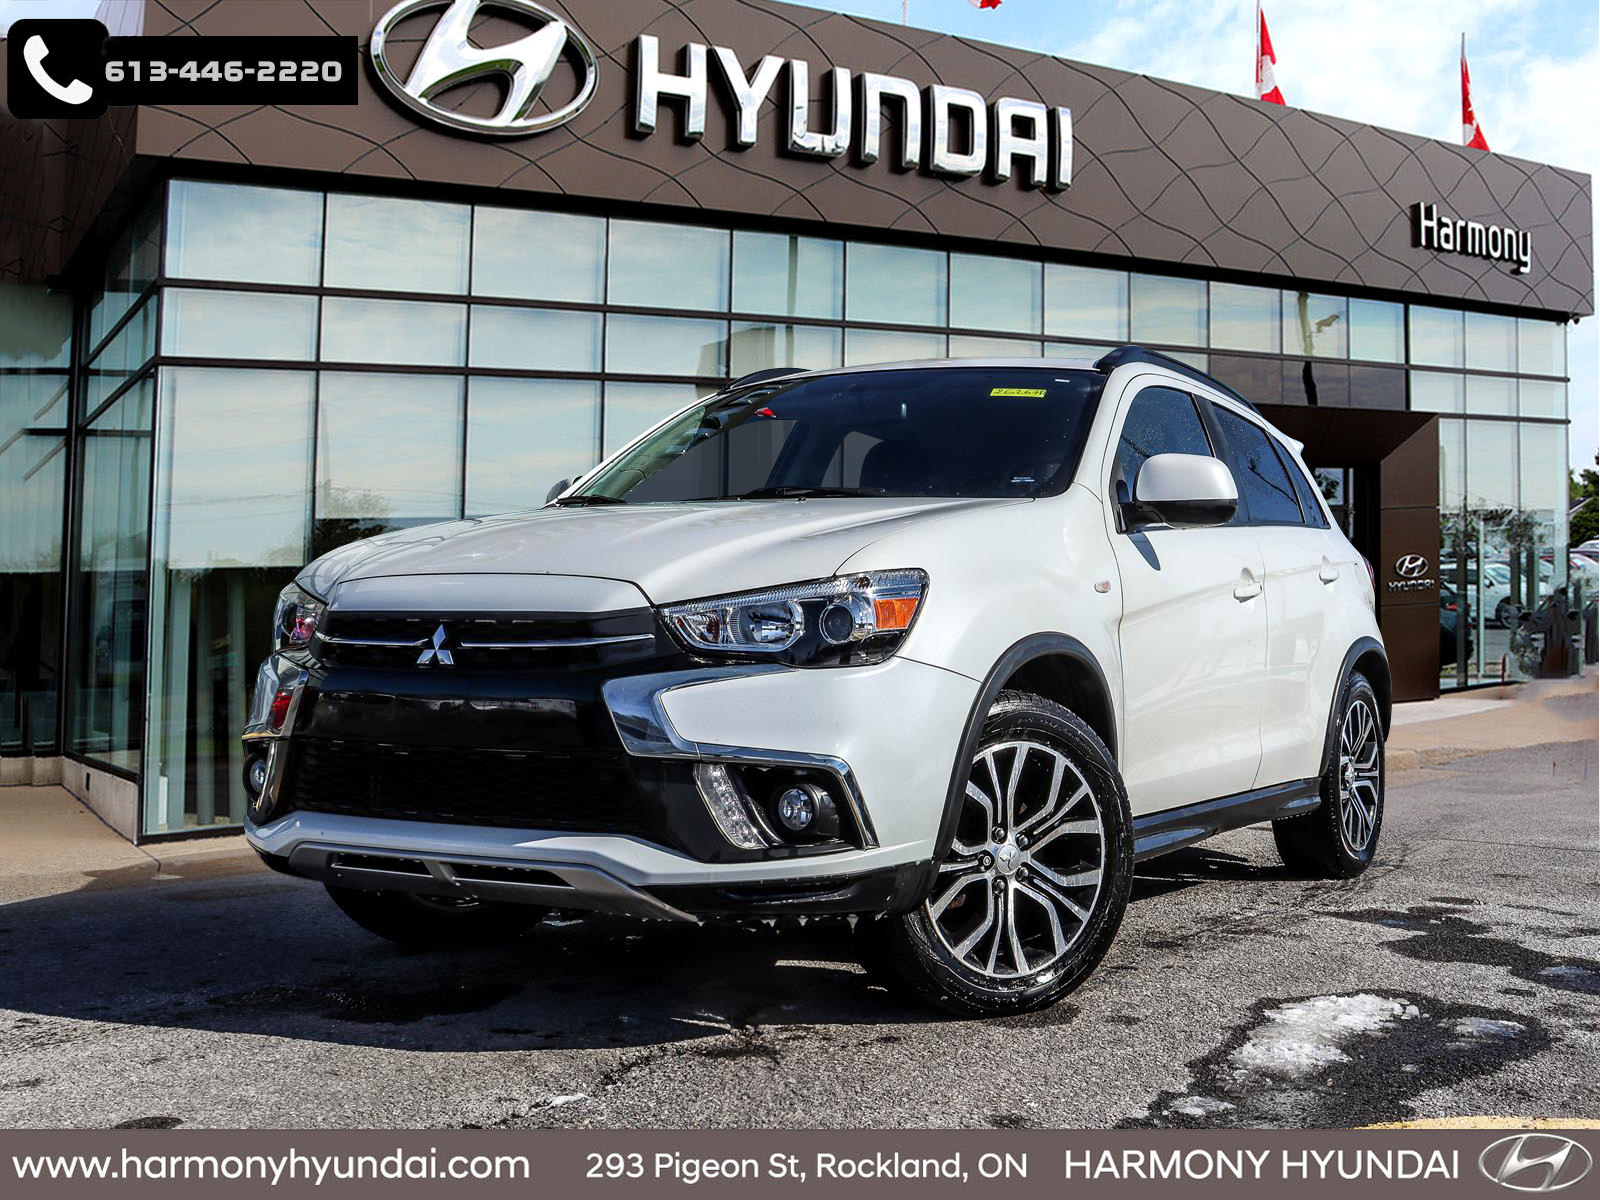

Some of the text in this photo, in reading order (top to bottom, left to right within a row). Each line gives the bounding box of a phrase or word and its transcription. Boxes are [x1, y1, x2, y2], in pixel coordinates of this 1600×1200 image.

[634, 33, 1074, 190] HYUNDAI
[1417, 201, 1531, 274] Harmony
[1388, 579, 1435, 592] HYUNDAI
